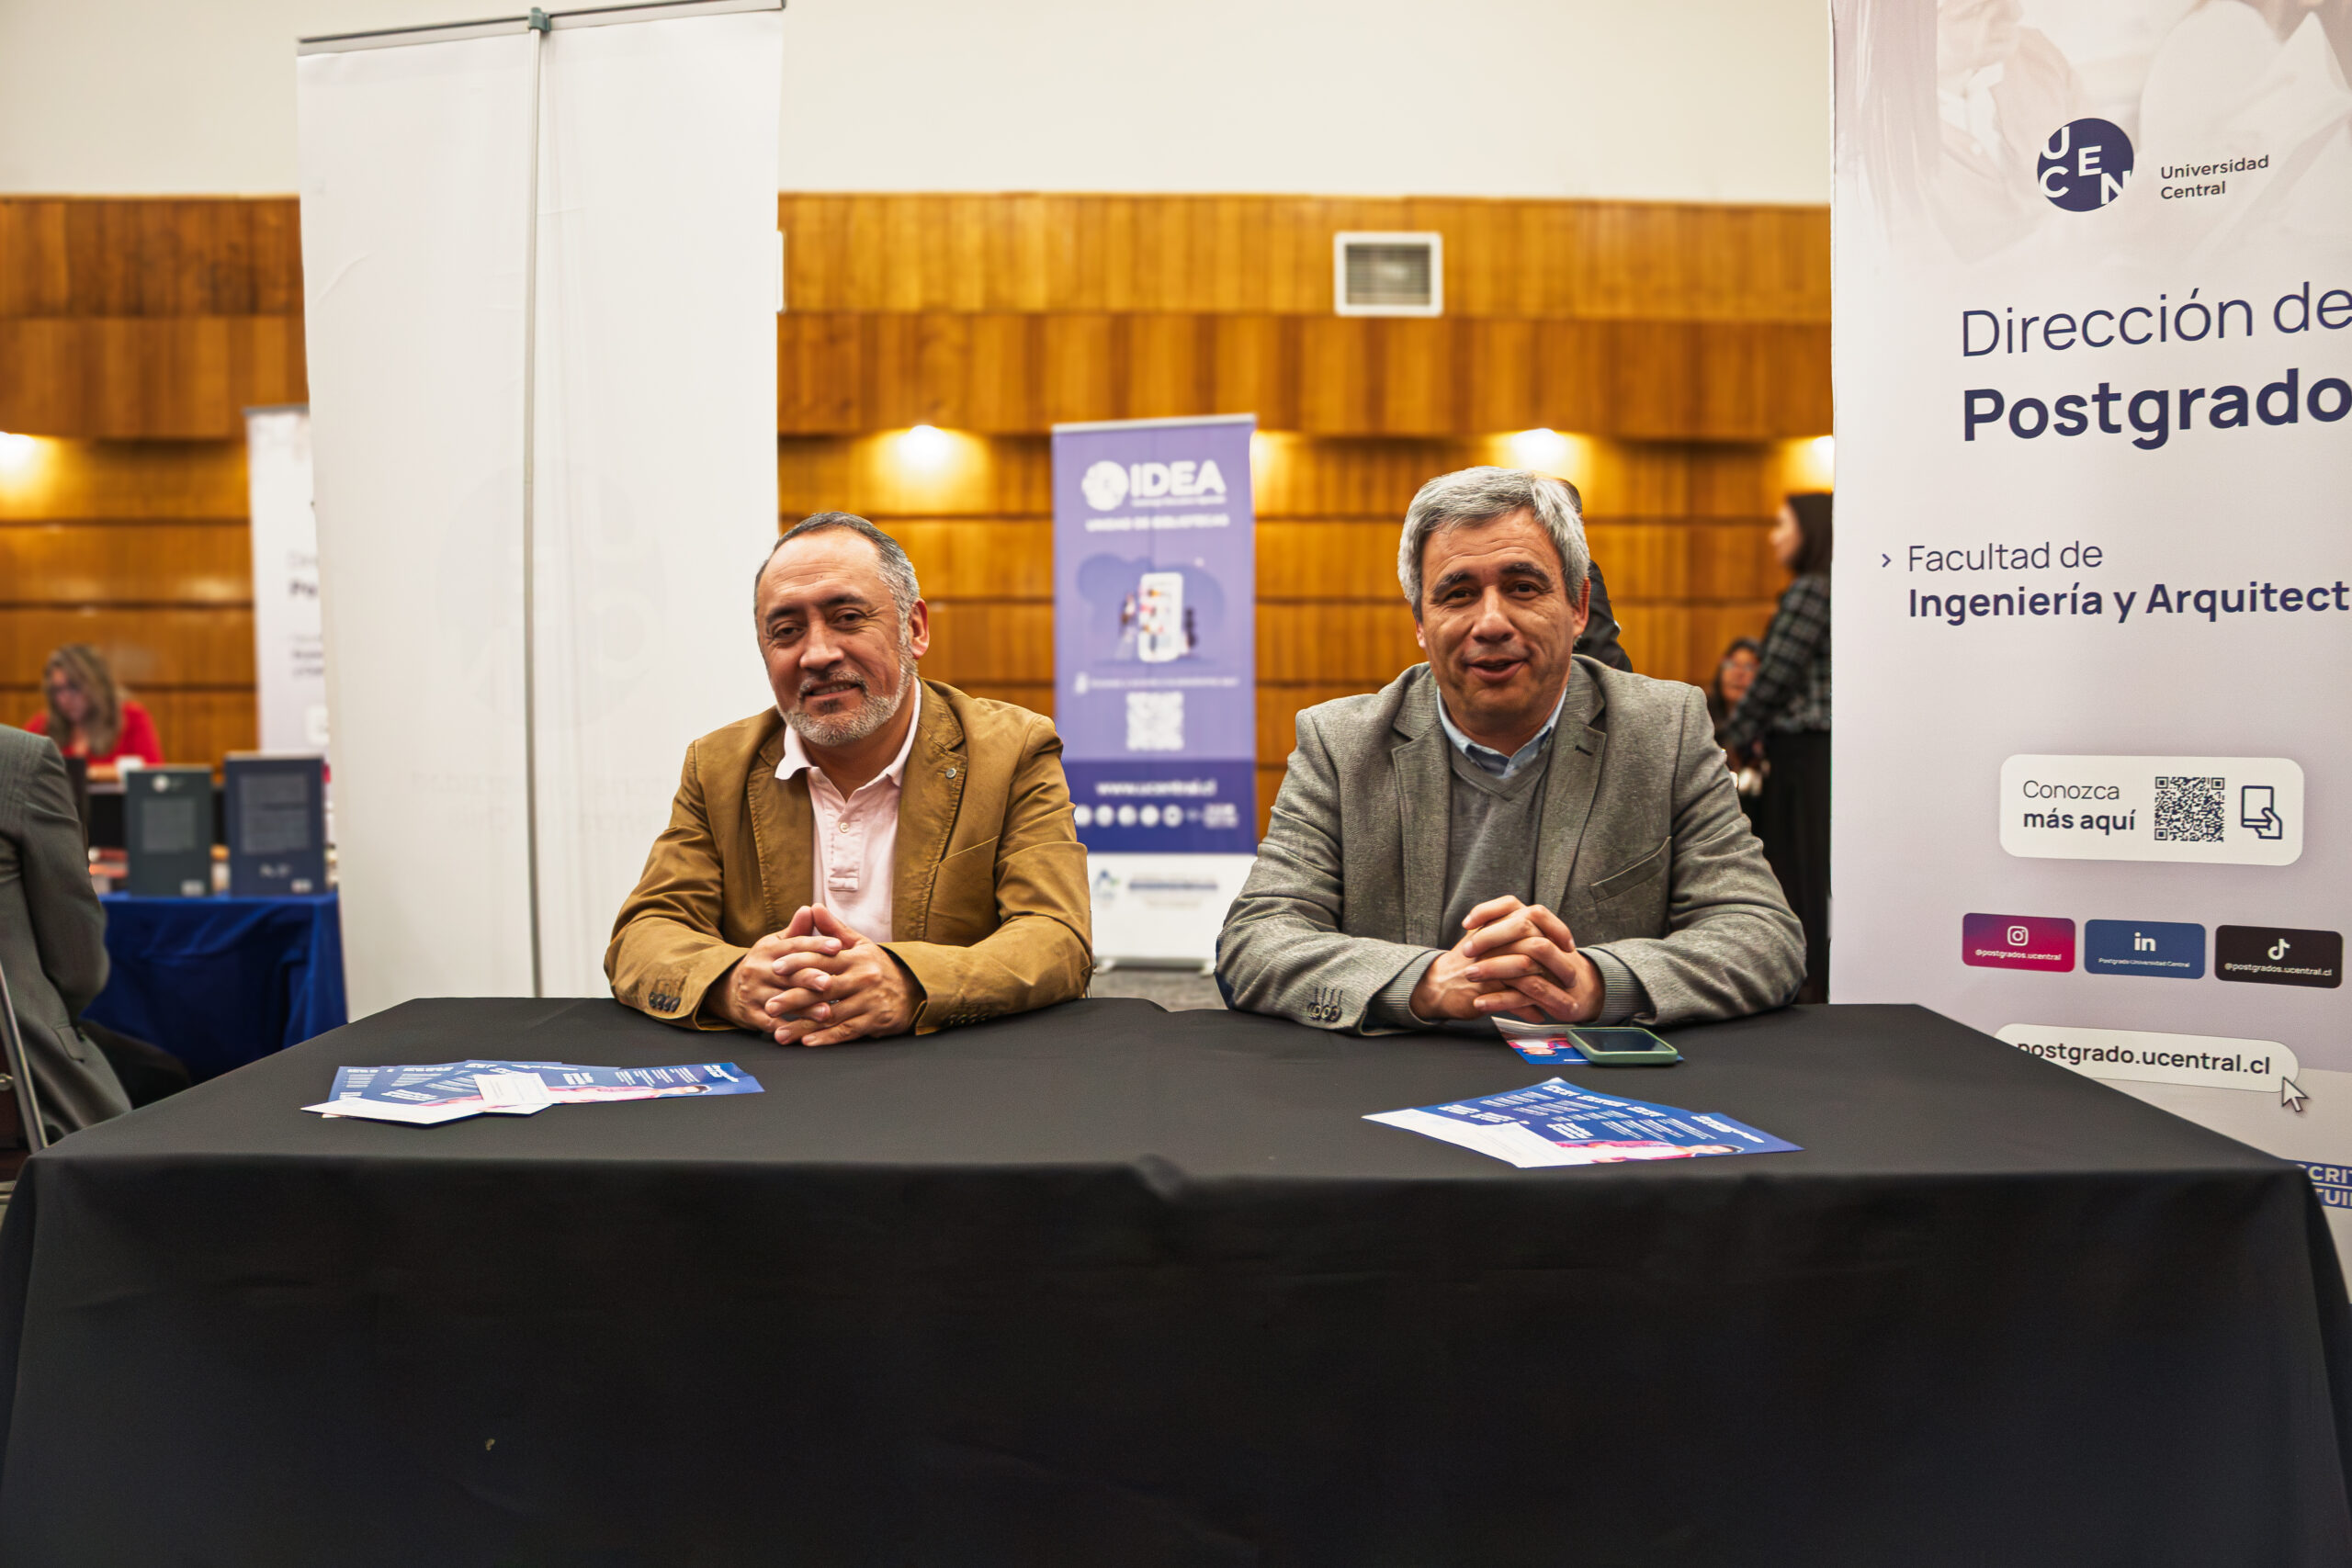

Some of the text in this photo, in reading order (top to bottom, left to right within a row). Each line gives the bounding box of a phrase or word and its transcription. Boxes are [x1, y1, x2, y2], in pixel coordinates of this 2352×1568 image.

[2161, 154, 2269, 180] Universidad
[2160, 180, 2226, 200] Central
[1962, 281, 2352, 357] Dirección de
[1963, 367, 2352, 451] Postgrado
[1130, 459, 1227, 497] IDEA
[1909, 540, 2103, 572] Facultad de
[1909, 581, 2350, 626] Ingeniería y Arquitect
[2023, 780, 2120, 801] Conozca
[2023, 807, 2137, 836] más aquí
[1975, 948, 2062, 961] @postgrados.ucentral
[2134, 931, 2156, 952] in
[2224, 962, 2333, 976] @postgrados.ucentral.cl
[2297, 1164, 2352, 1184] CRI
